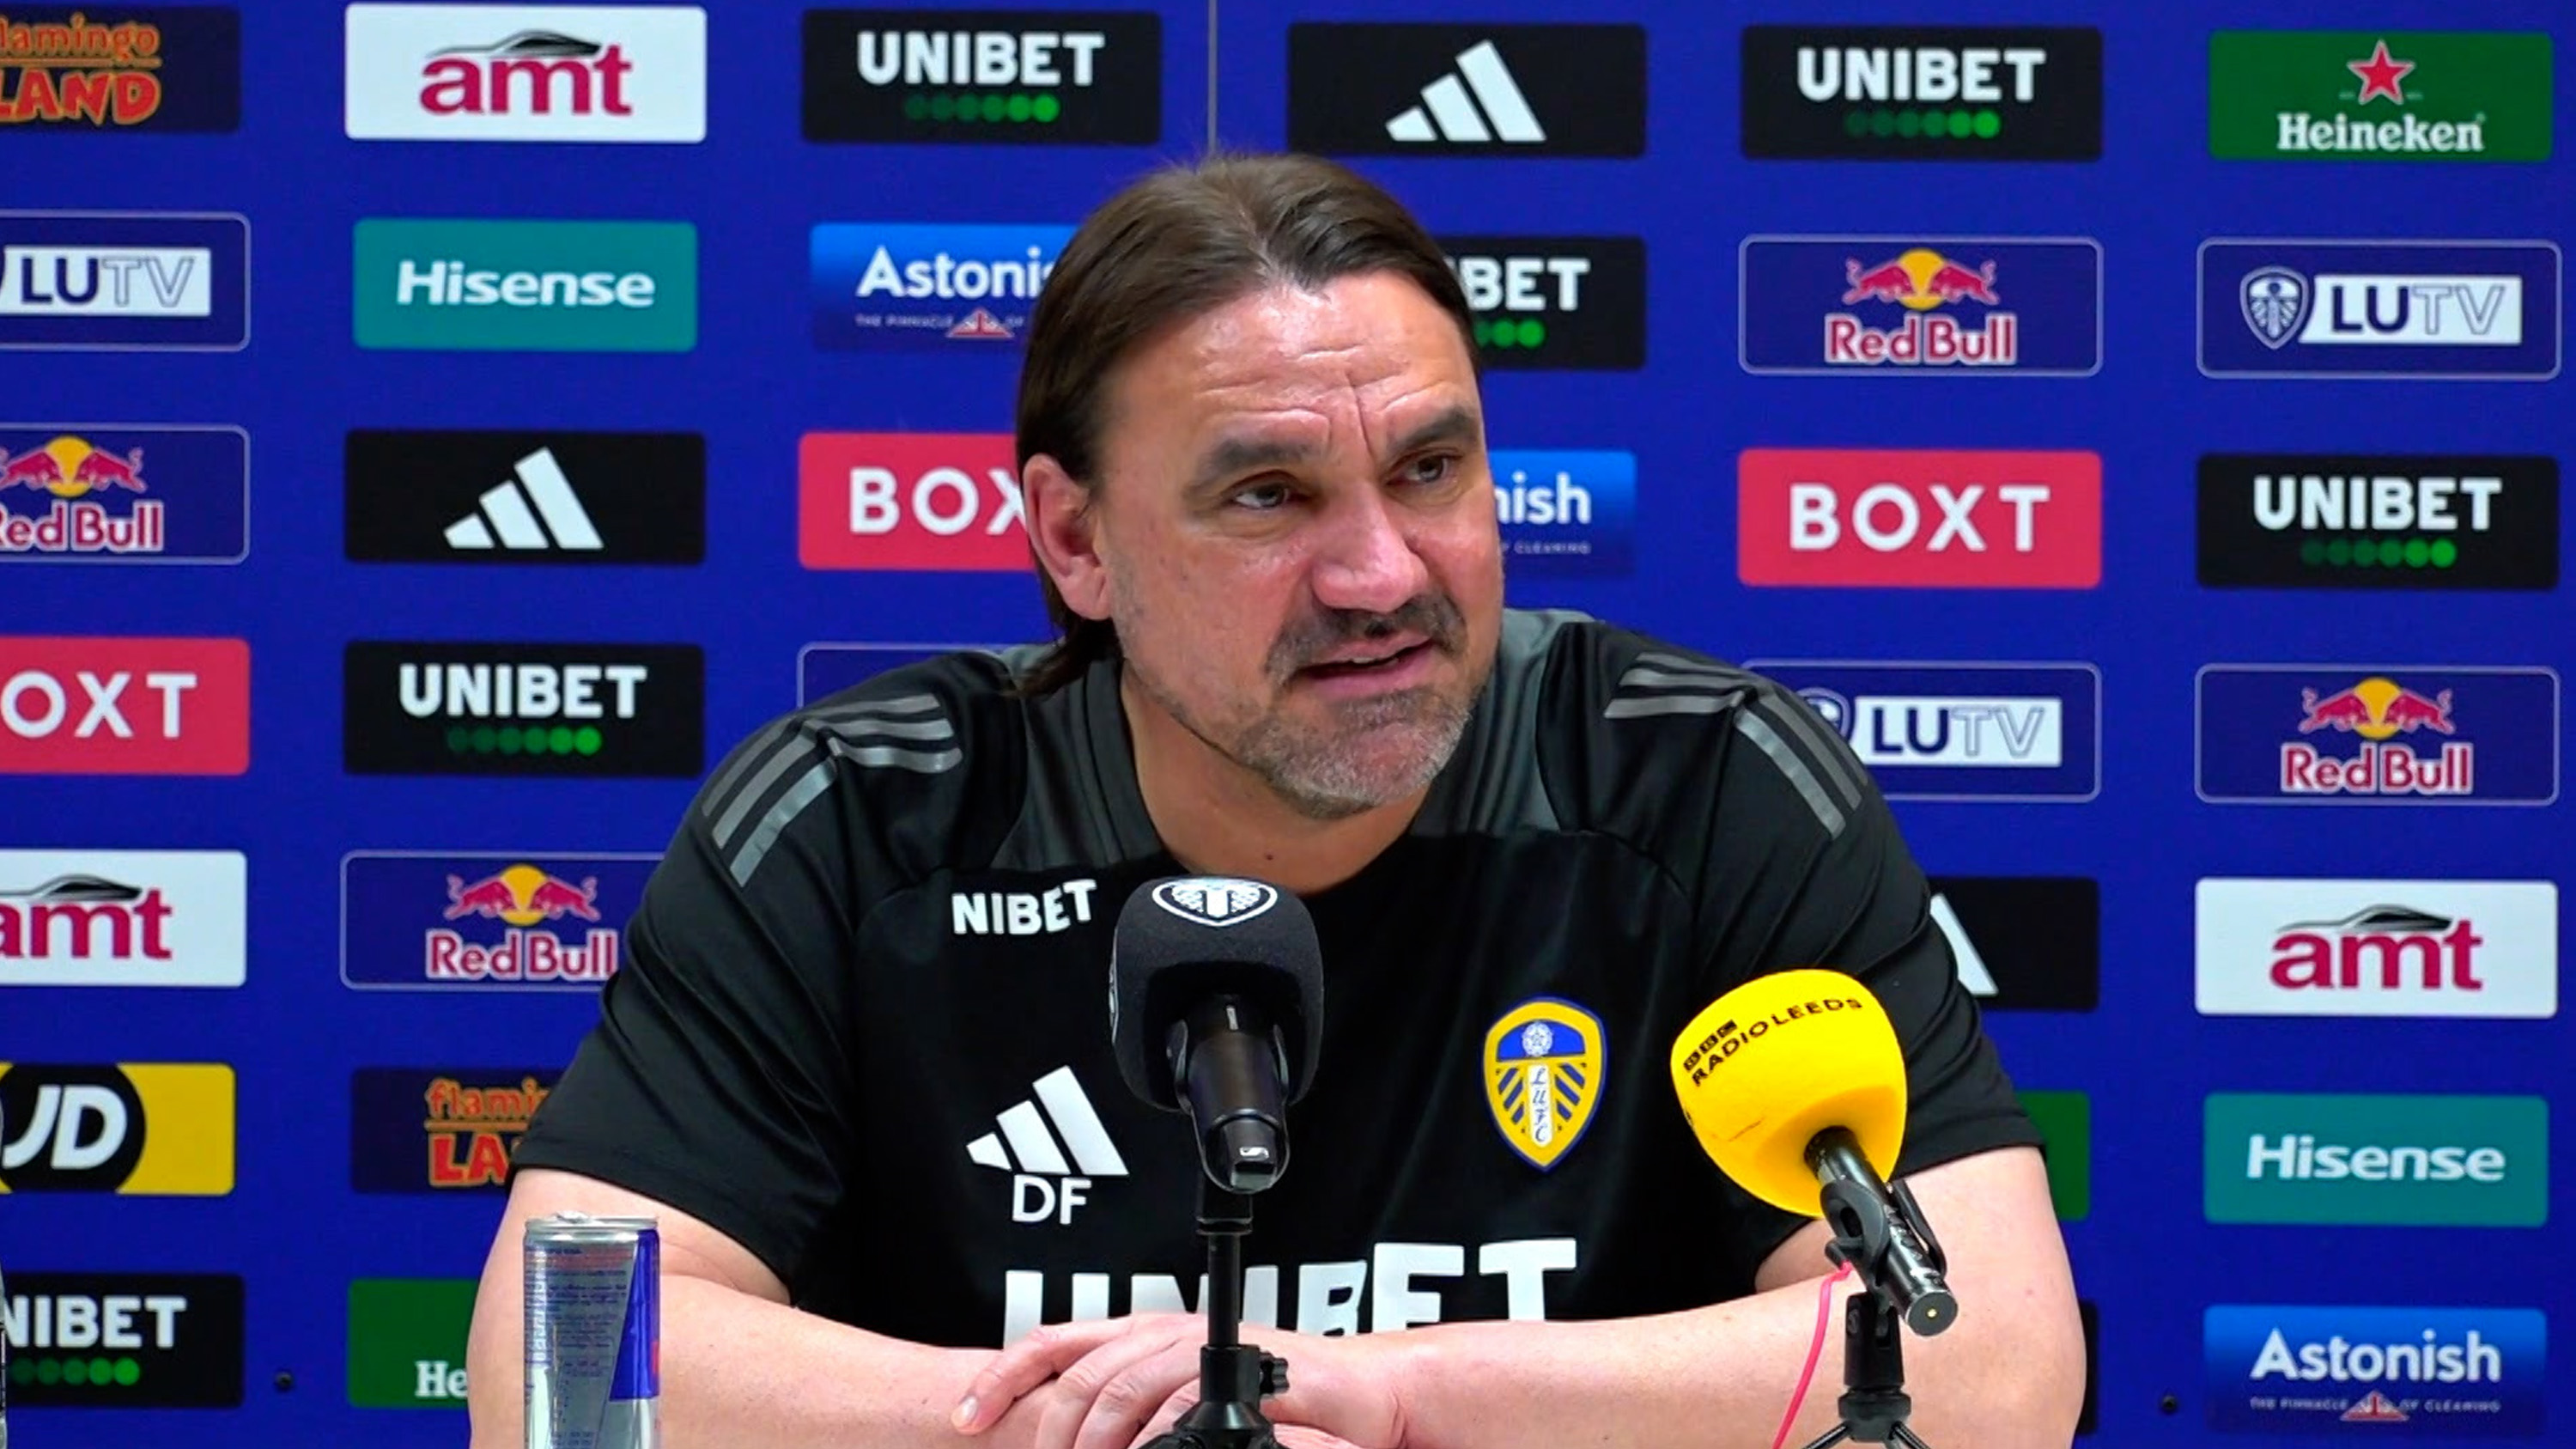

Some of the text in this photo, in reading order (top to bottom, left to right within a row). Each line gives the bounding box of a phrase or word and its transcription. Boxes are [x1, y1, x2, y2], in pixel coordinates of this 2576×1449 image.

[420, 43, 633, 116] amt
[858, 31, 1105, 87] UNIBET
[1797, 47, 2046, 101] UNIBET
[2277, 113, 2485, 152] Heineken
[21, 258, 195, 306] LUTV
[397, 260, 656, 308] Hisense
[1443, 256, 1590, 311] BET
[2330, 284, 2505, 335] LUTV
[1824, 313, 2018, 365] Red Bull
[0, 500, 163, 553] ed Bull
[1789, 484, 2050, 551] BOXT
[2253, 476, 2502, 530] UNIBET
[0, 669, 197, 739] OXT
[398, 663, 647, 718] UNIBET
[1872, 706, 2044, 757] LUTV
[2281, 742, 2474, 795] Red Bull
[426, 929, 618, 982] Red Bull
[2269, 920, 2483, 990] amt
[1692, 1021, 1769, 1087] RADIO
[425, 1078, 550, 1117] flami
[2, 1085, 127, 1169] JD
[429, 1131, 520, 1187] LA
[2246, 1135, 2505, 1181] Hisense
[1012, 1174, 1092, 1225] DF
[2250, 1327, 2500, 1381] Astonish
